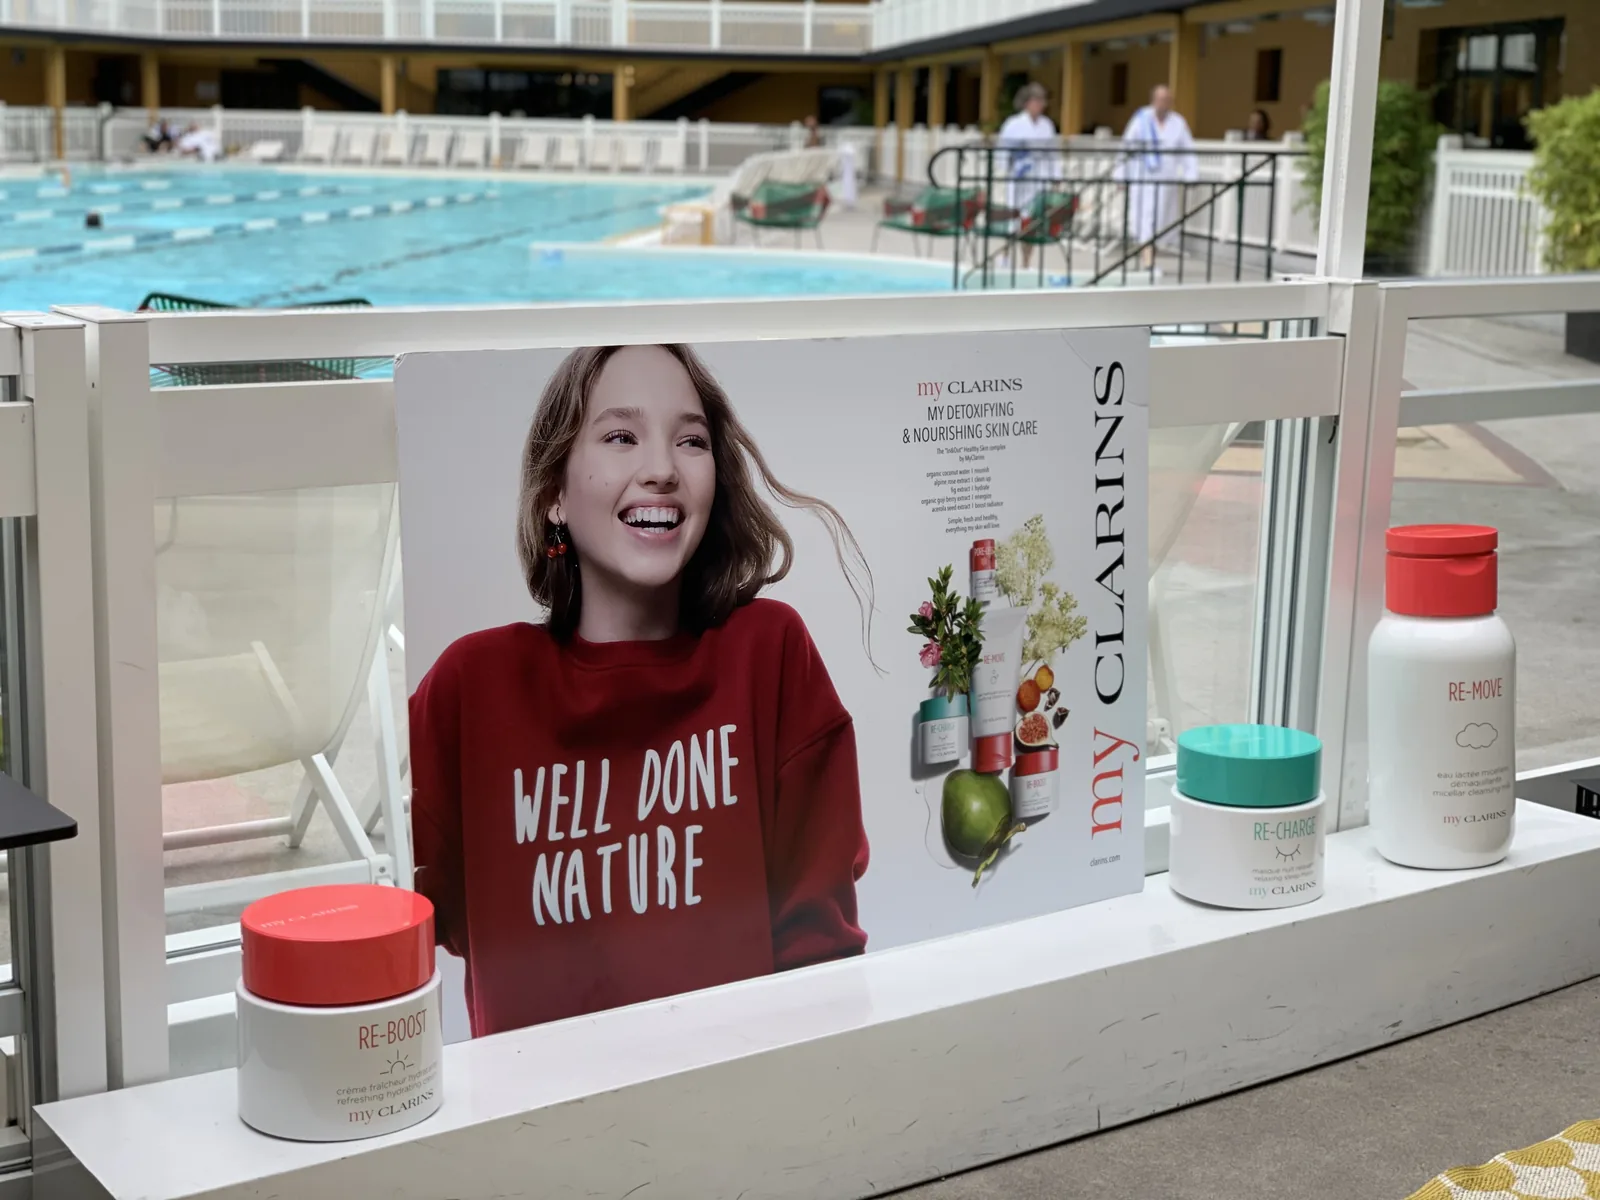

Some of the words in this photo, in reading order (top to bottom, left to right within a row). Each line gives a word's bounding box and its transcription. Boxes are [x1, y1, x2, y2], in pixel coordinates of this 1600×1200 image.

[917, 381, 944, 402] my
[947, 378, 1023, 394] CLARINS
[927, 405, 944, 421] MY
[947, 401, 1014, 420] DETOXIFYING
[902, 428, 911, 444] &
[913, 423, 982, 443] NOURISHING
[985, 422, 1009, 438] SKIN
[1012, 420, 1038, 436] CARE
[926, 471, 941, 479] organic
[921, 498, 936, 506] organic
[1094, 361, 1126, 705] CLARINS
[1449, 678, 1503, 702] RE-MOVE
[514, 758, 611, 844] WELL
[637, 724, 739, 821] DONE
[1092, 726, 1140, 840] my
[1433, 788, 1466, 797] micellar
[1254, 815, 1316, 841] RE-CHARGE
[1443, 814, 1461, 827] my
[1464, 810, 1507, 823] CLARINS
[1090, 854, 1121, 867] clarins.com
[532, 824, 703, 926] NATURE
[1249, 886, 1267, 899] my
[1272, 880, 1316, 895] CLARINS
[359, 1008, 427, 1050] RE-BOOST
[337, 1091, 385, 1105] refreshing
[386, 1080, 422, 1098] hydrating
[349, 1108, 374, 1125] my
[378, 1088, 434, 1117] CLARINS
